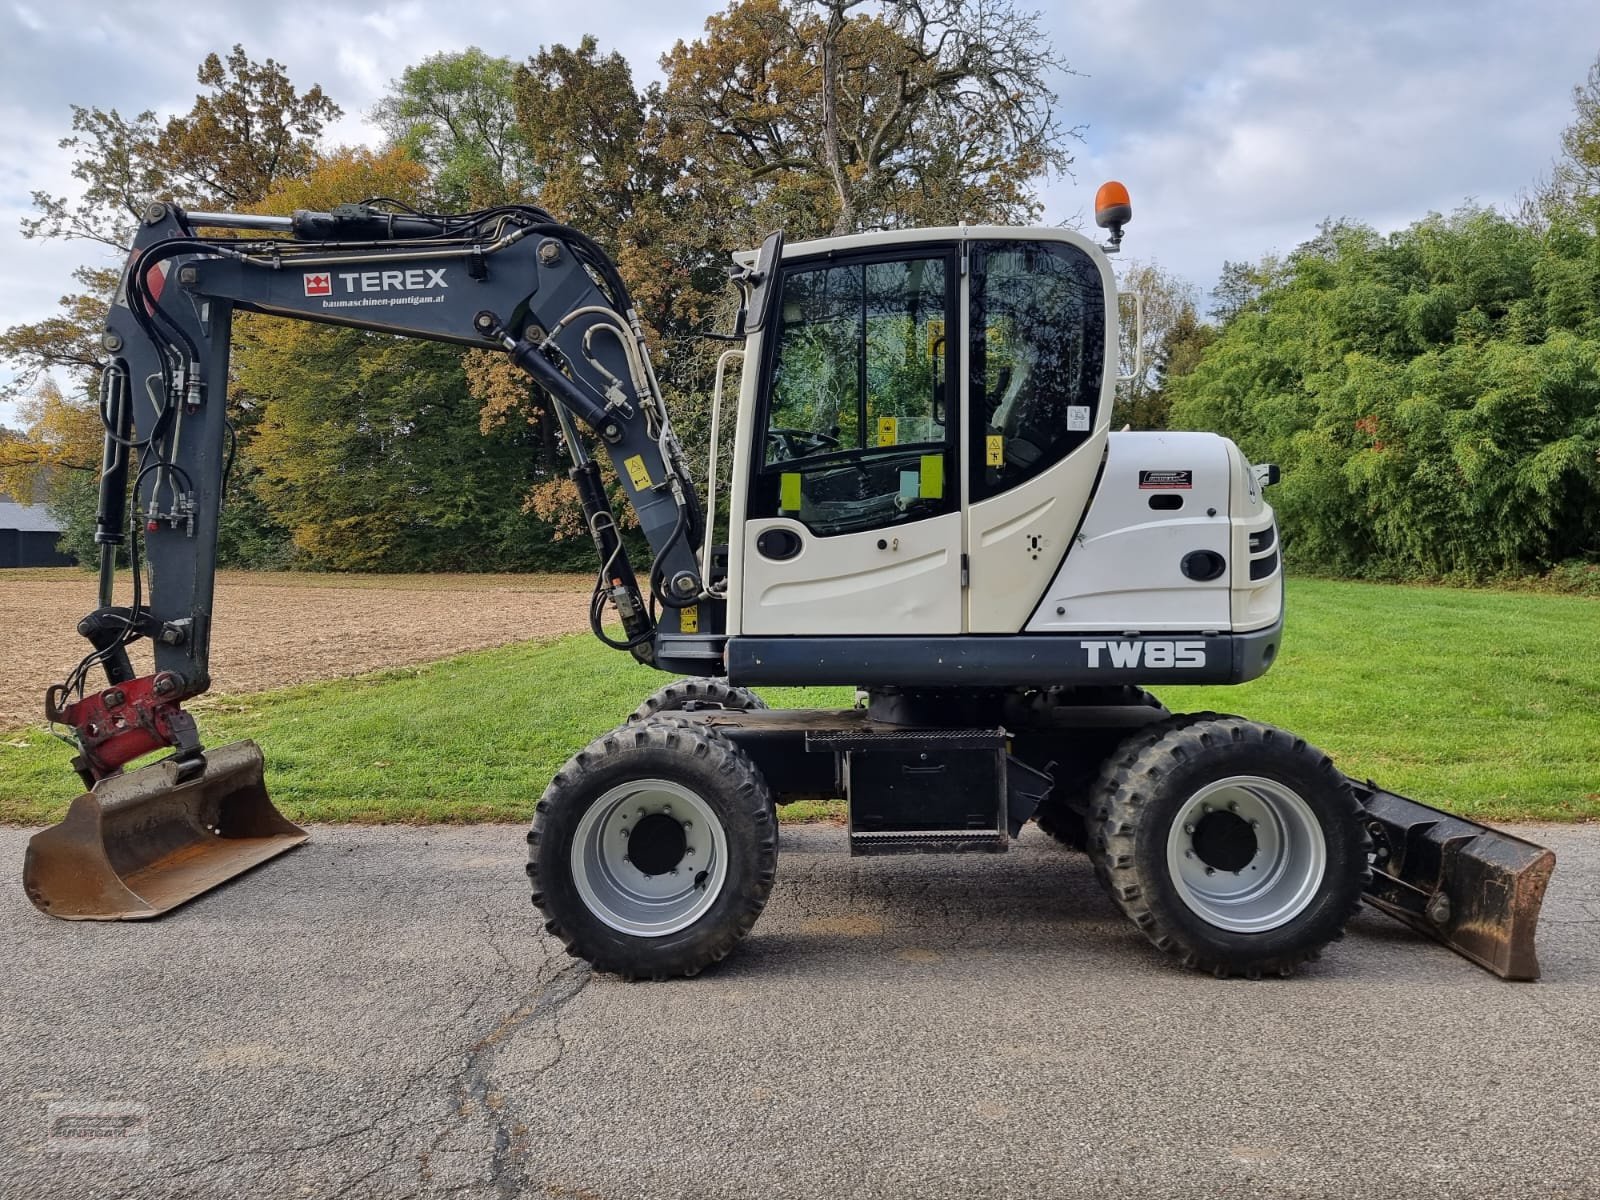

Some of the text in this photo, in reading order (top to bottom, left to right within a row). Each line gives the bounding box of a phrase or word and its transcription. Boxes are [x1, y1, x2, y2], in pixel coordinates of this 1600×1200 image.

[338, 268, 449, 293] TEREX
[322, 294, 445, 308] baumaschinen-puntigam.at
[1080, 641, 1206, 668] TW85
